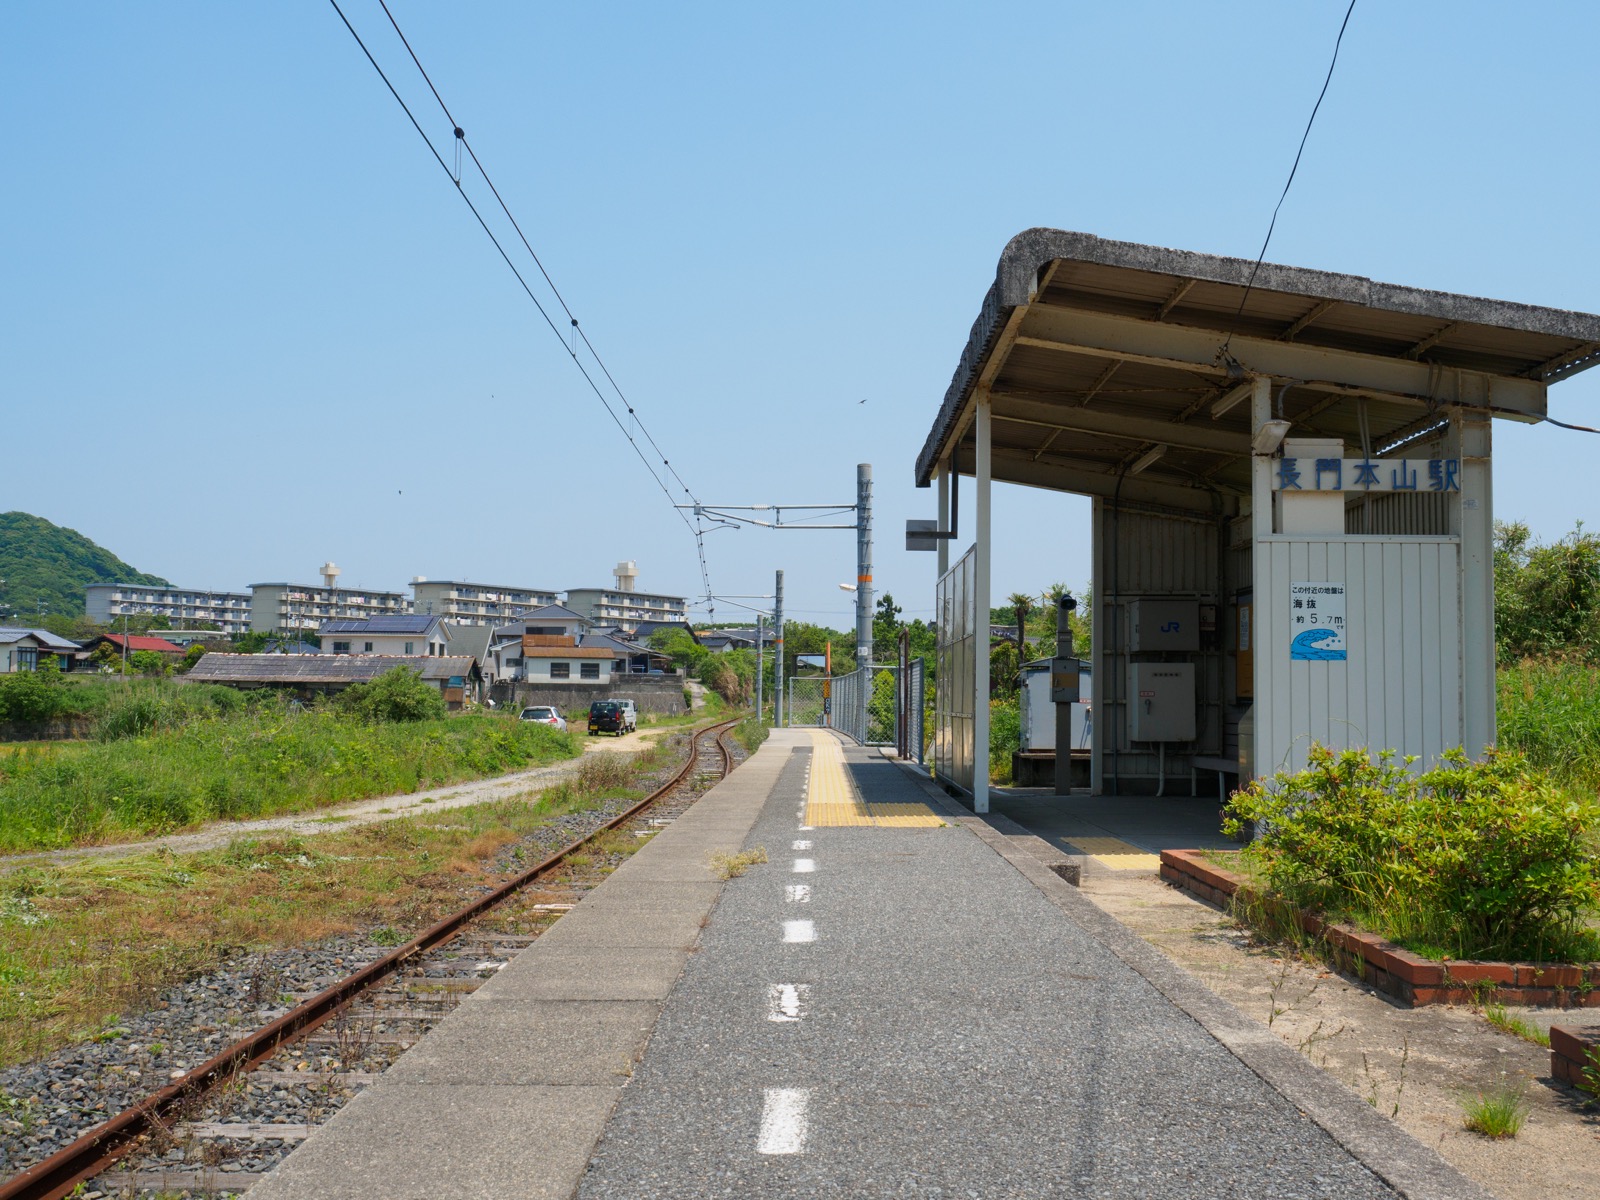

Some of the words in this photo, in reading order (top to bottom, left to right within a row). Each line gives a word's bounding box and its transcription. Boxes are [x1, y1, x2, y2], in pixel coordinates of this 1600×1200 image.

[1276, 457, 1460, 491] 長門本山駅
[1292, 586, 1344, 595] この付近の地盤は
[1160, 621, 1180, 633] JR
